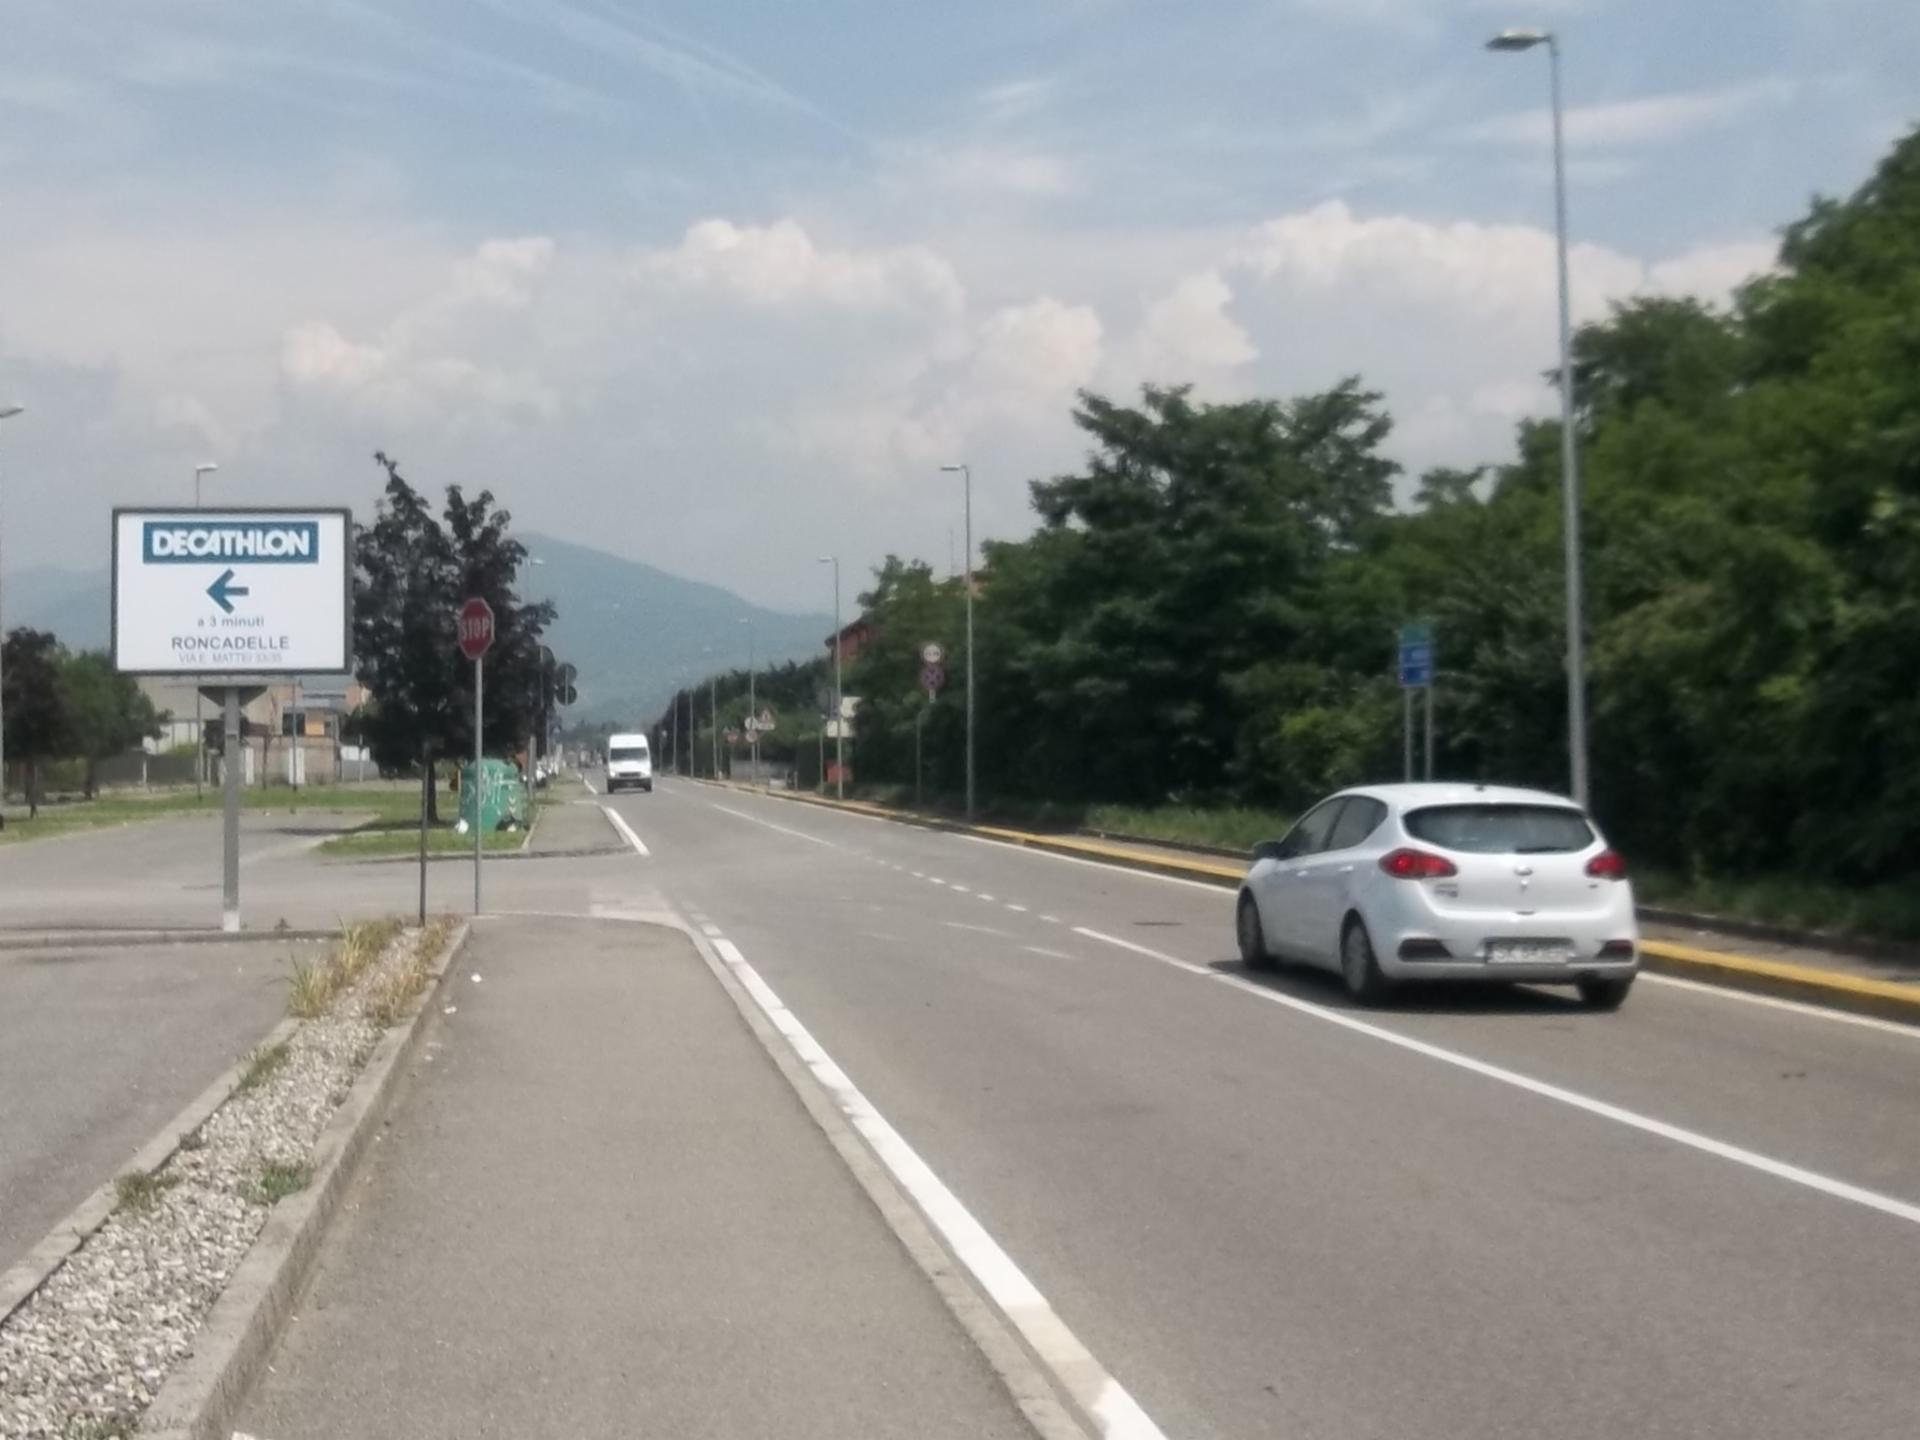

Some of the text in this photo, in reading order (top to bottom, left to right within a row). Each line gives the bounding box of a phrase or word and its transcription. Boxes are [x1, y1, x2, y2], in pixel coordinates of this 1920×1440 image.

[152, 529, 310, 557] DECATHLON
[197, 616, 264, 627] a 3 minuti
[461, 617, 491, 639] STOP
[171, 636, 289, 649] RONCADELLE
